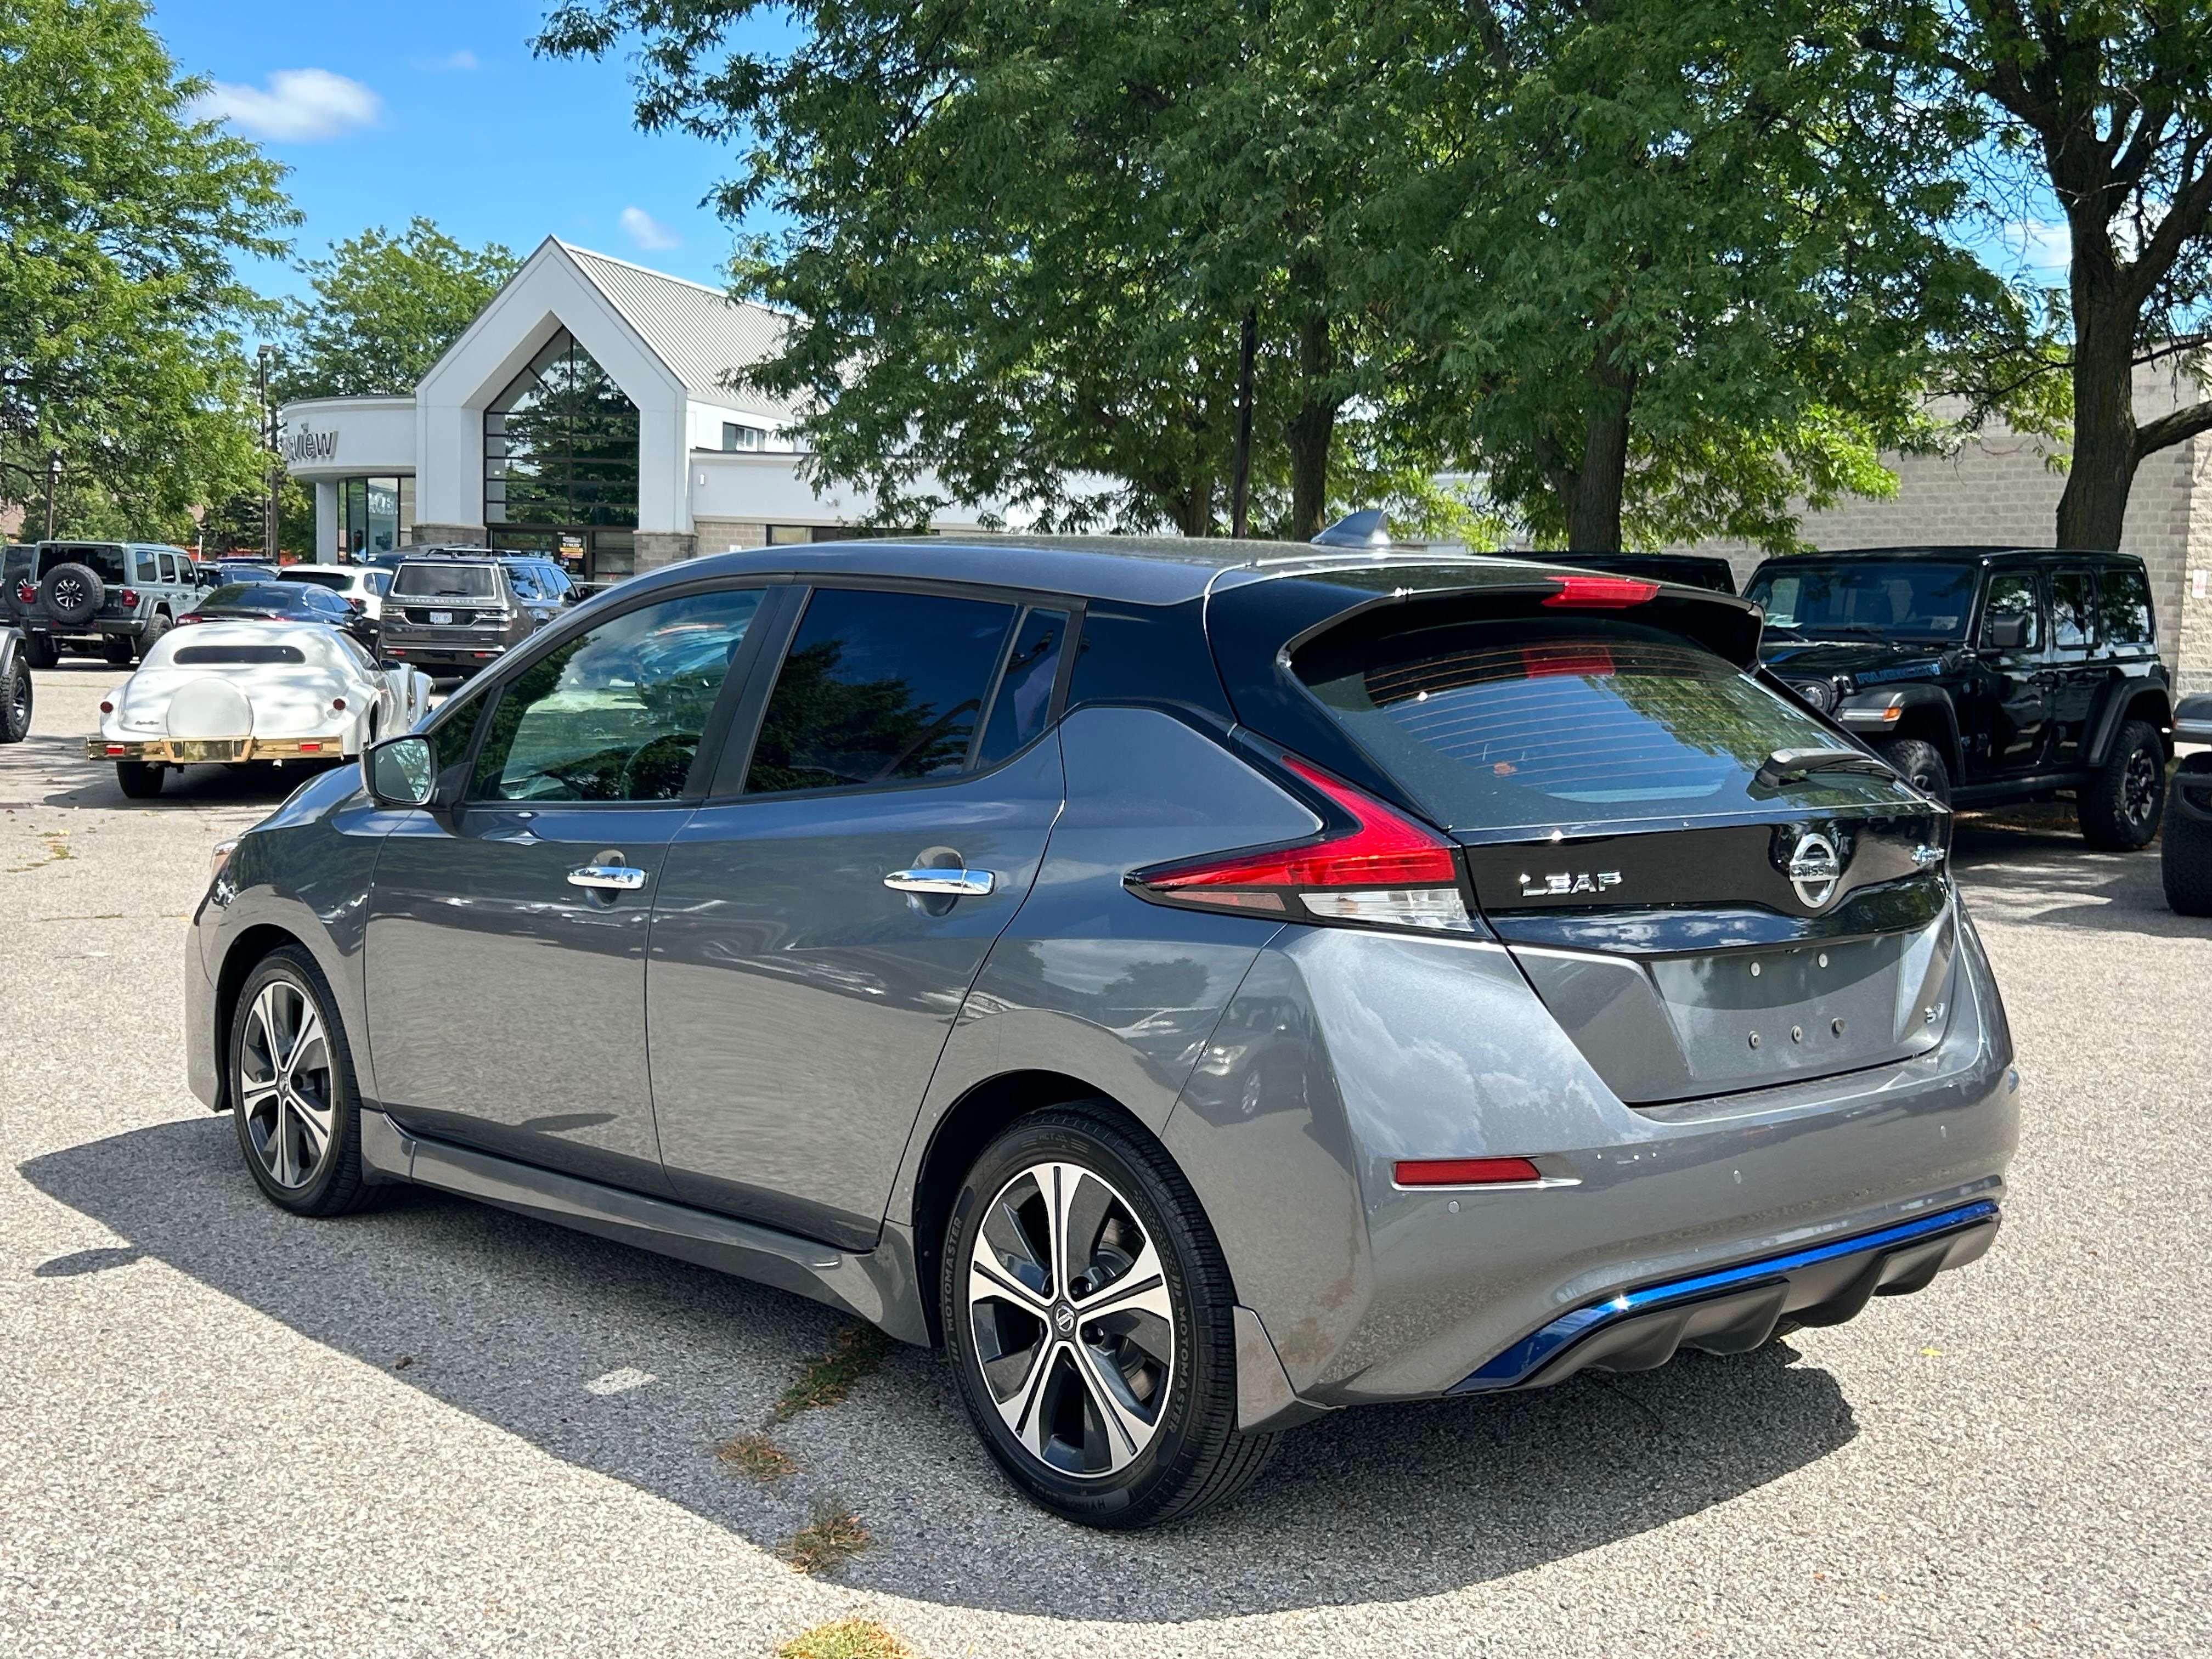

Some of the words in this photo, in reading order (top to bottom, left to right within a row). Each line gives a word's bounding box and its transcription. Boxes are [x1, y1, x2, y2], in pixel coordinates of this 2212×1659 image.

[1855, 663, 1940, 685] RUBICON
[944, 1216, 963, 1332] MOTOMASTER
[1167, 1305, 1189, 1435] MOTOMASTER
